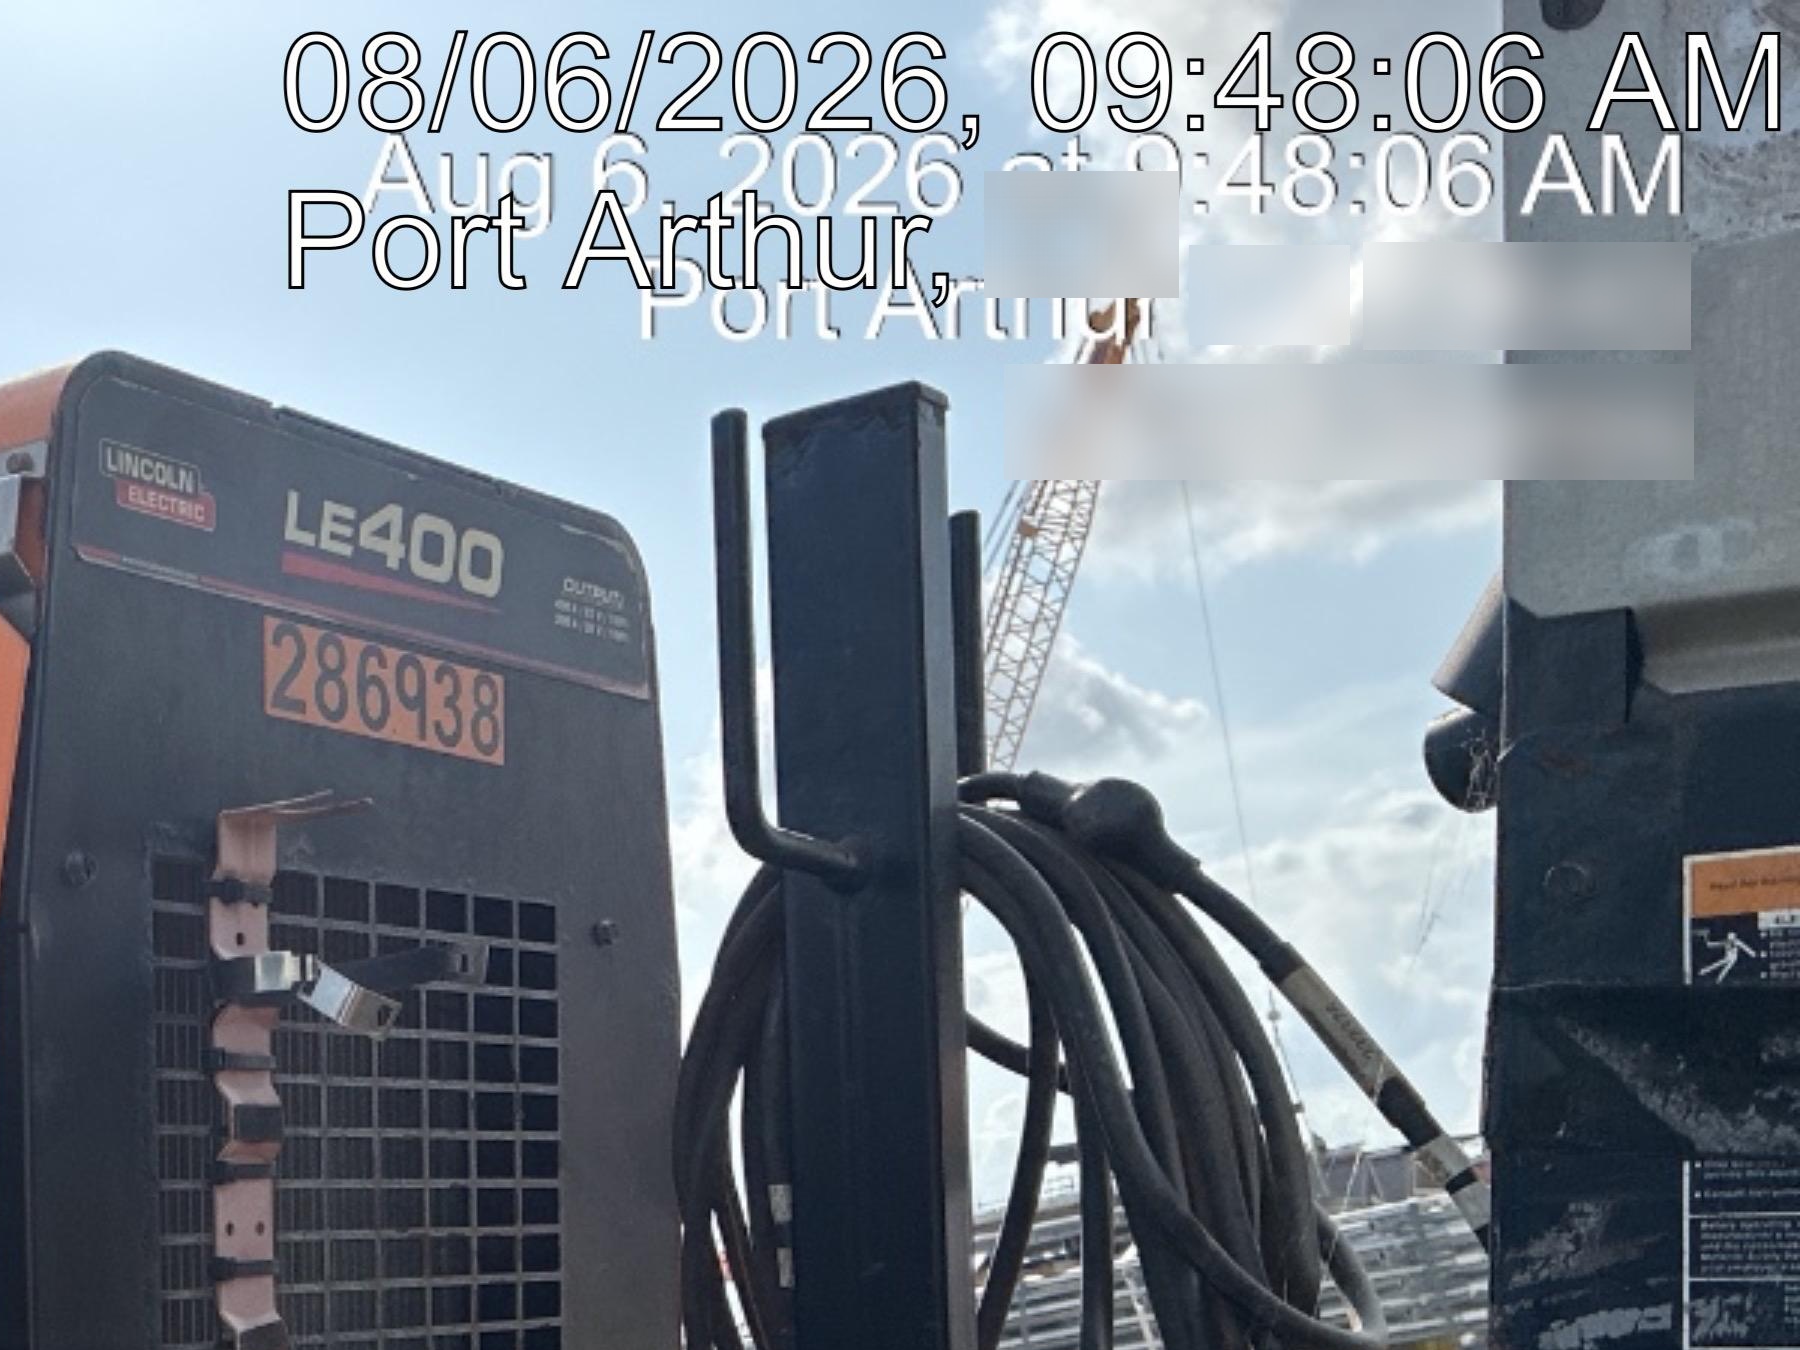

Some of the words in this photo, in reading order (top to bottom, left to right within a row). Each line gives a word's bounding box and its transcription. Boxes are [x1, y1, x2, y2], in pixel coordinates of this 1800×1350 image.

[106, 446, 194, 494] LINCOLN
[128, 485, 206, 523] ELECTRIC
[284, 490, 503, 598] LE400
[269, 622, 502, 757] 286938
